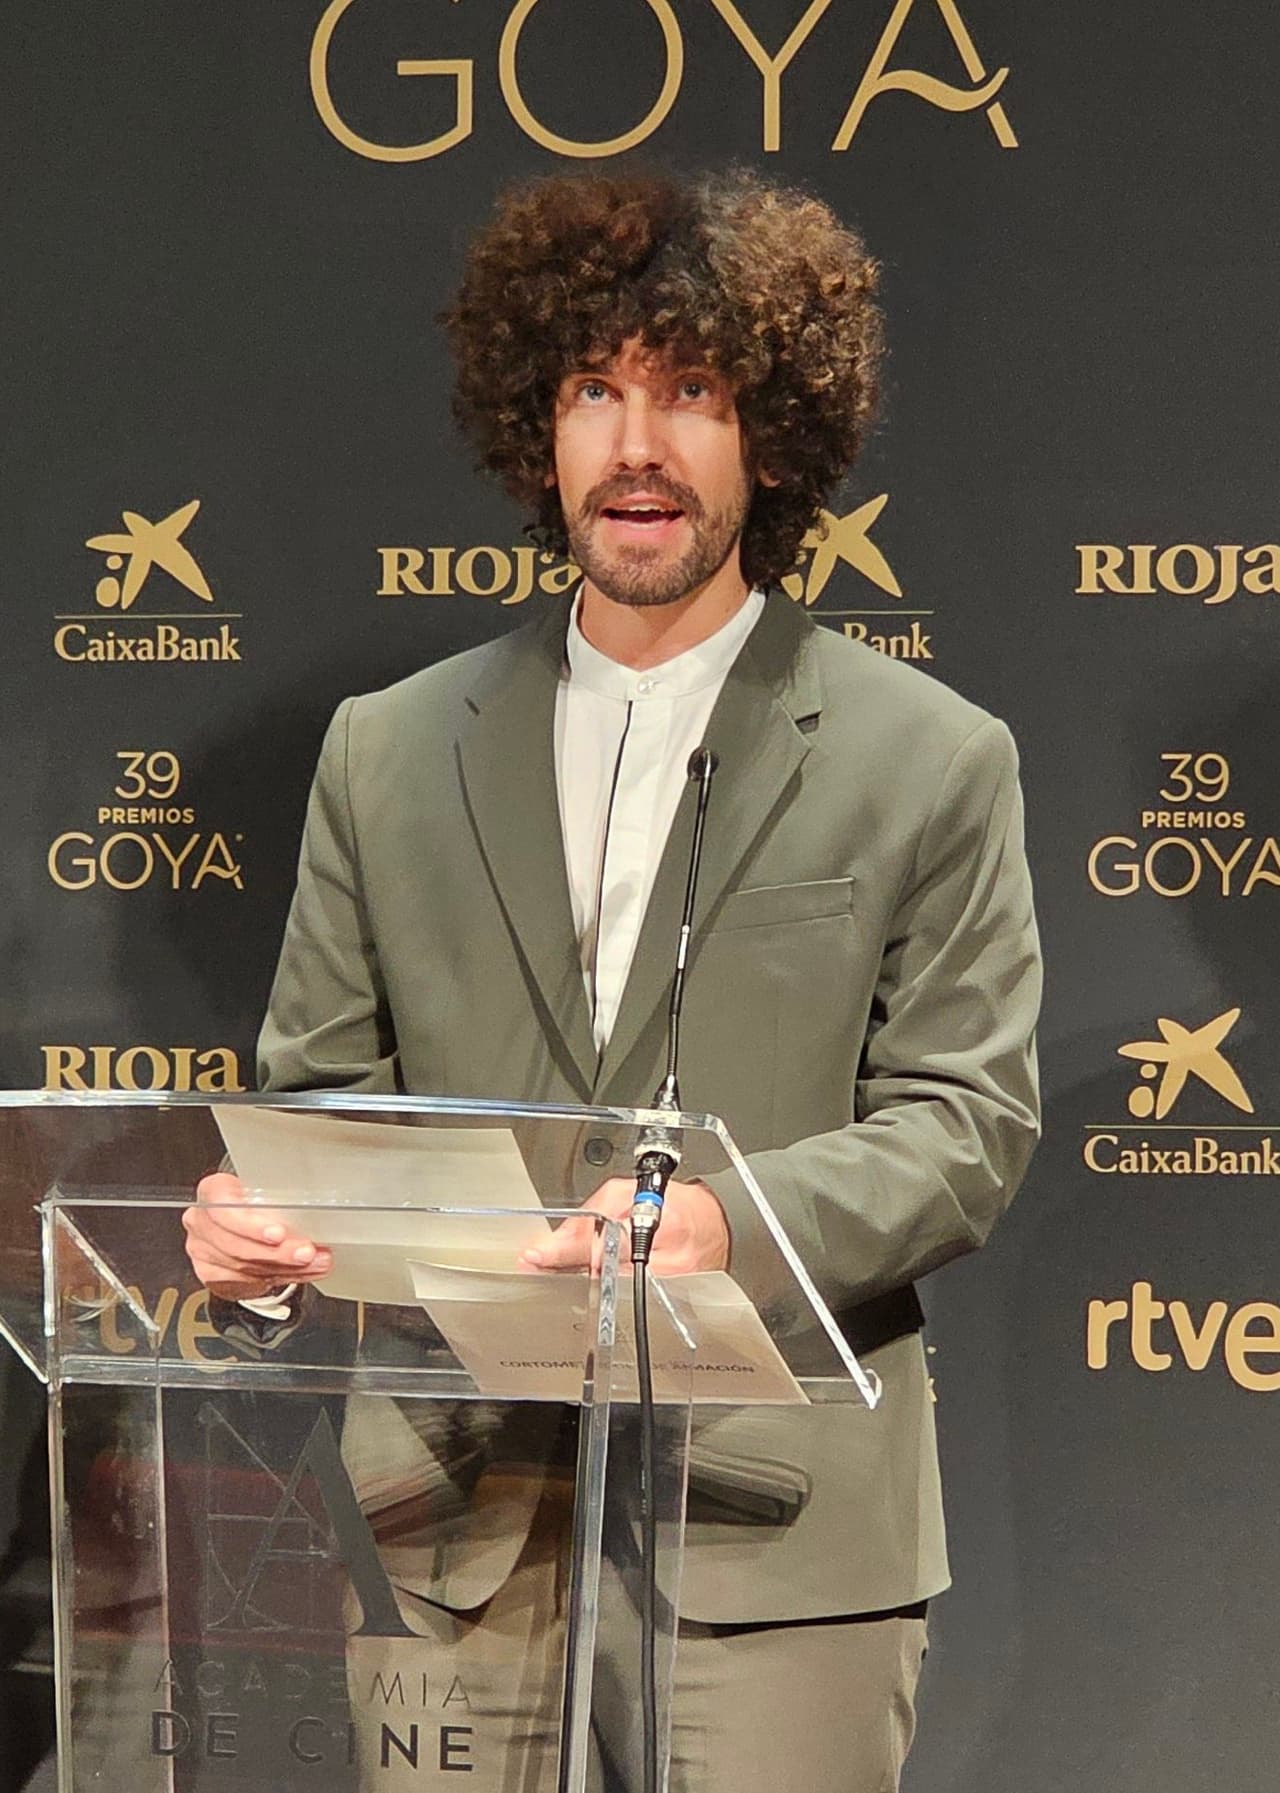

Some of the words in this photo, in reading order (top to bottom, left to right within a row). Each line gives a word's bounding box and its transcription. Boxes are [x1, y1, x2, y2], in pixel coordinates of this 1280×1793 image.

[309, 0, 1019, 163] GOYA
[53, 623, 242, 662] CaixaBank
[115, 750, 181, 800] 39
[1159, 752, 1231, 803] 39
[97, 807, 196, 825] PREMIOS
[1141, 810, 1246, 829] PREMIOS
[47, 831, 245, 891] GOYA
[150, 1709, 241, 1759] DE
[287, 1716, 474, 1772] CINE
